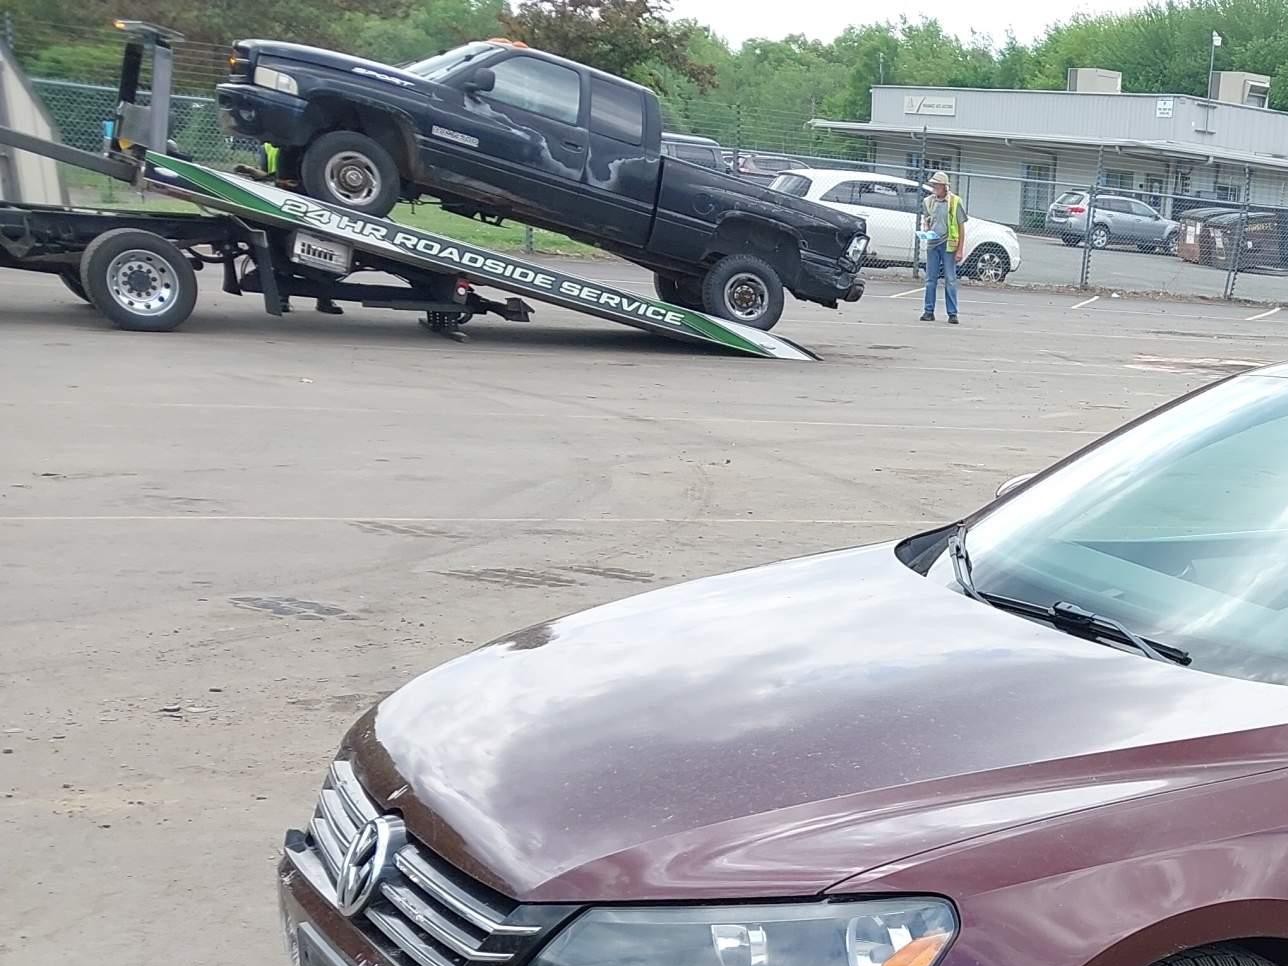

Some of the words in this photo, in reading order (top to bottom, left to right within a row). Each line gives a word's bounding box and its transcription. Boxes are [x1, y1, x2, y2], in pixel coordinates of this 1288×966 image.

[352, 66, 416, 87] SPORT
[280, 199, 332, 225] 24
[337, 218, 389, 241] HR
[394, 231, 556, 288] ROADSIDE
[559, 280, 686, 327] SERVICE
